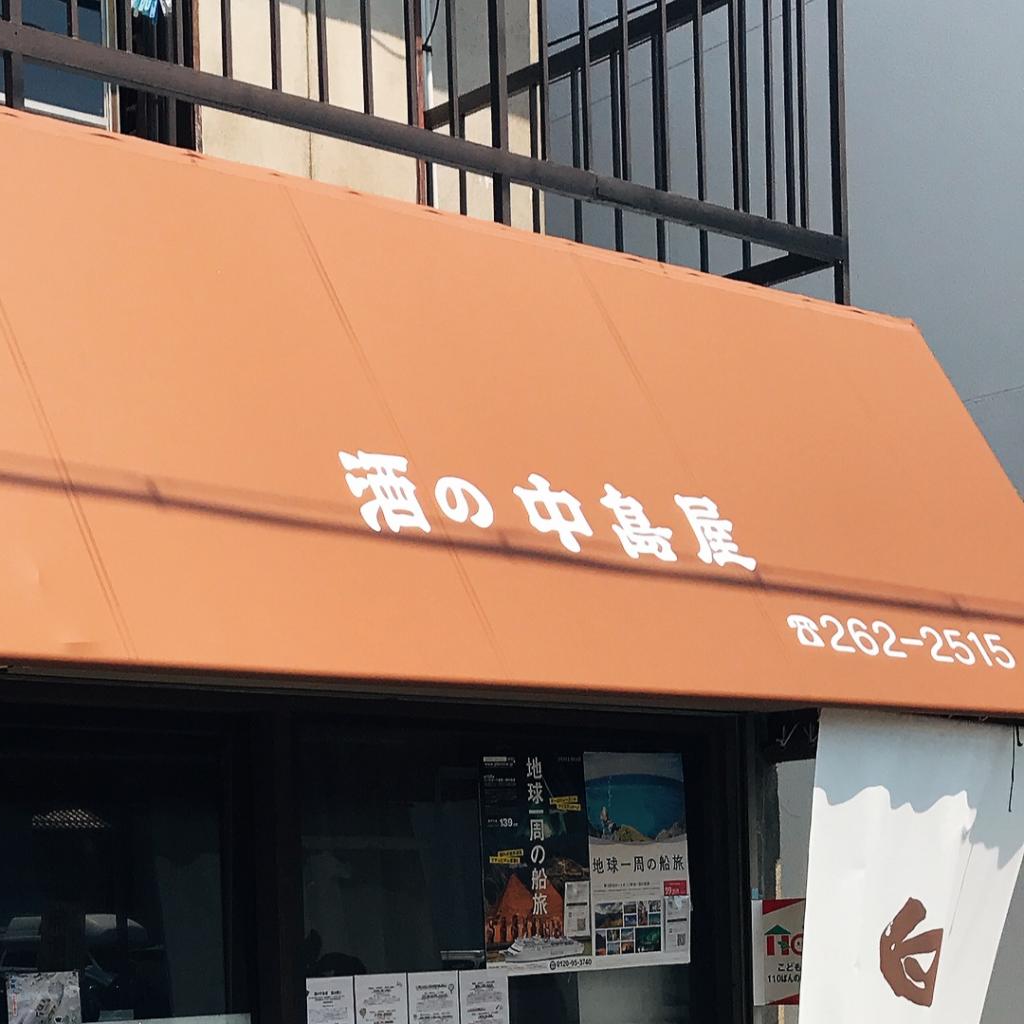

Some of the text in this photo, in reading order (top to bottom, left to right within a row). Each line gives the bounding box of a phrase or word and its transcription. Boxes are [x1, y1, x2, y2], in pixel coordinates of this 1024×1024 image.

[339, 450, 757, 572] 酒の中島屋
[819, 614, 1016, 670] 262-2515
[525, 756, 548, 916] 地球一周の船旅
[592, 855, 685, 873] 地球一周の船旅
